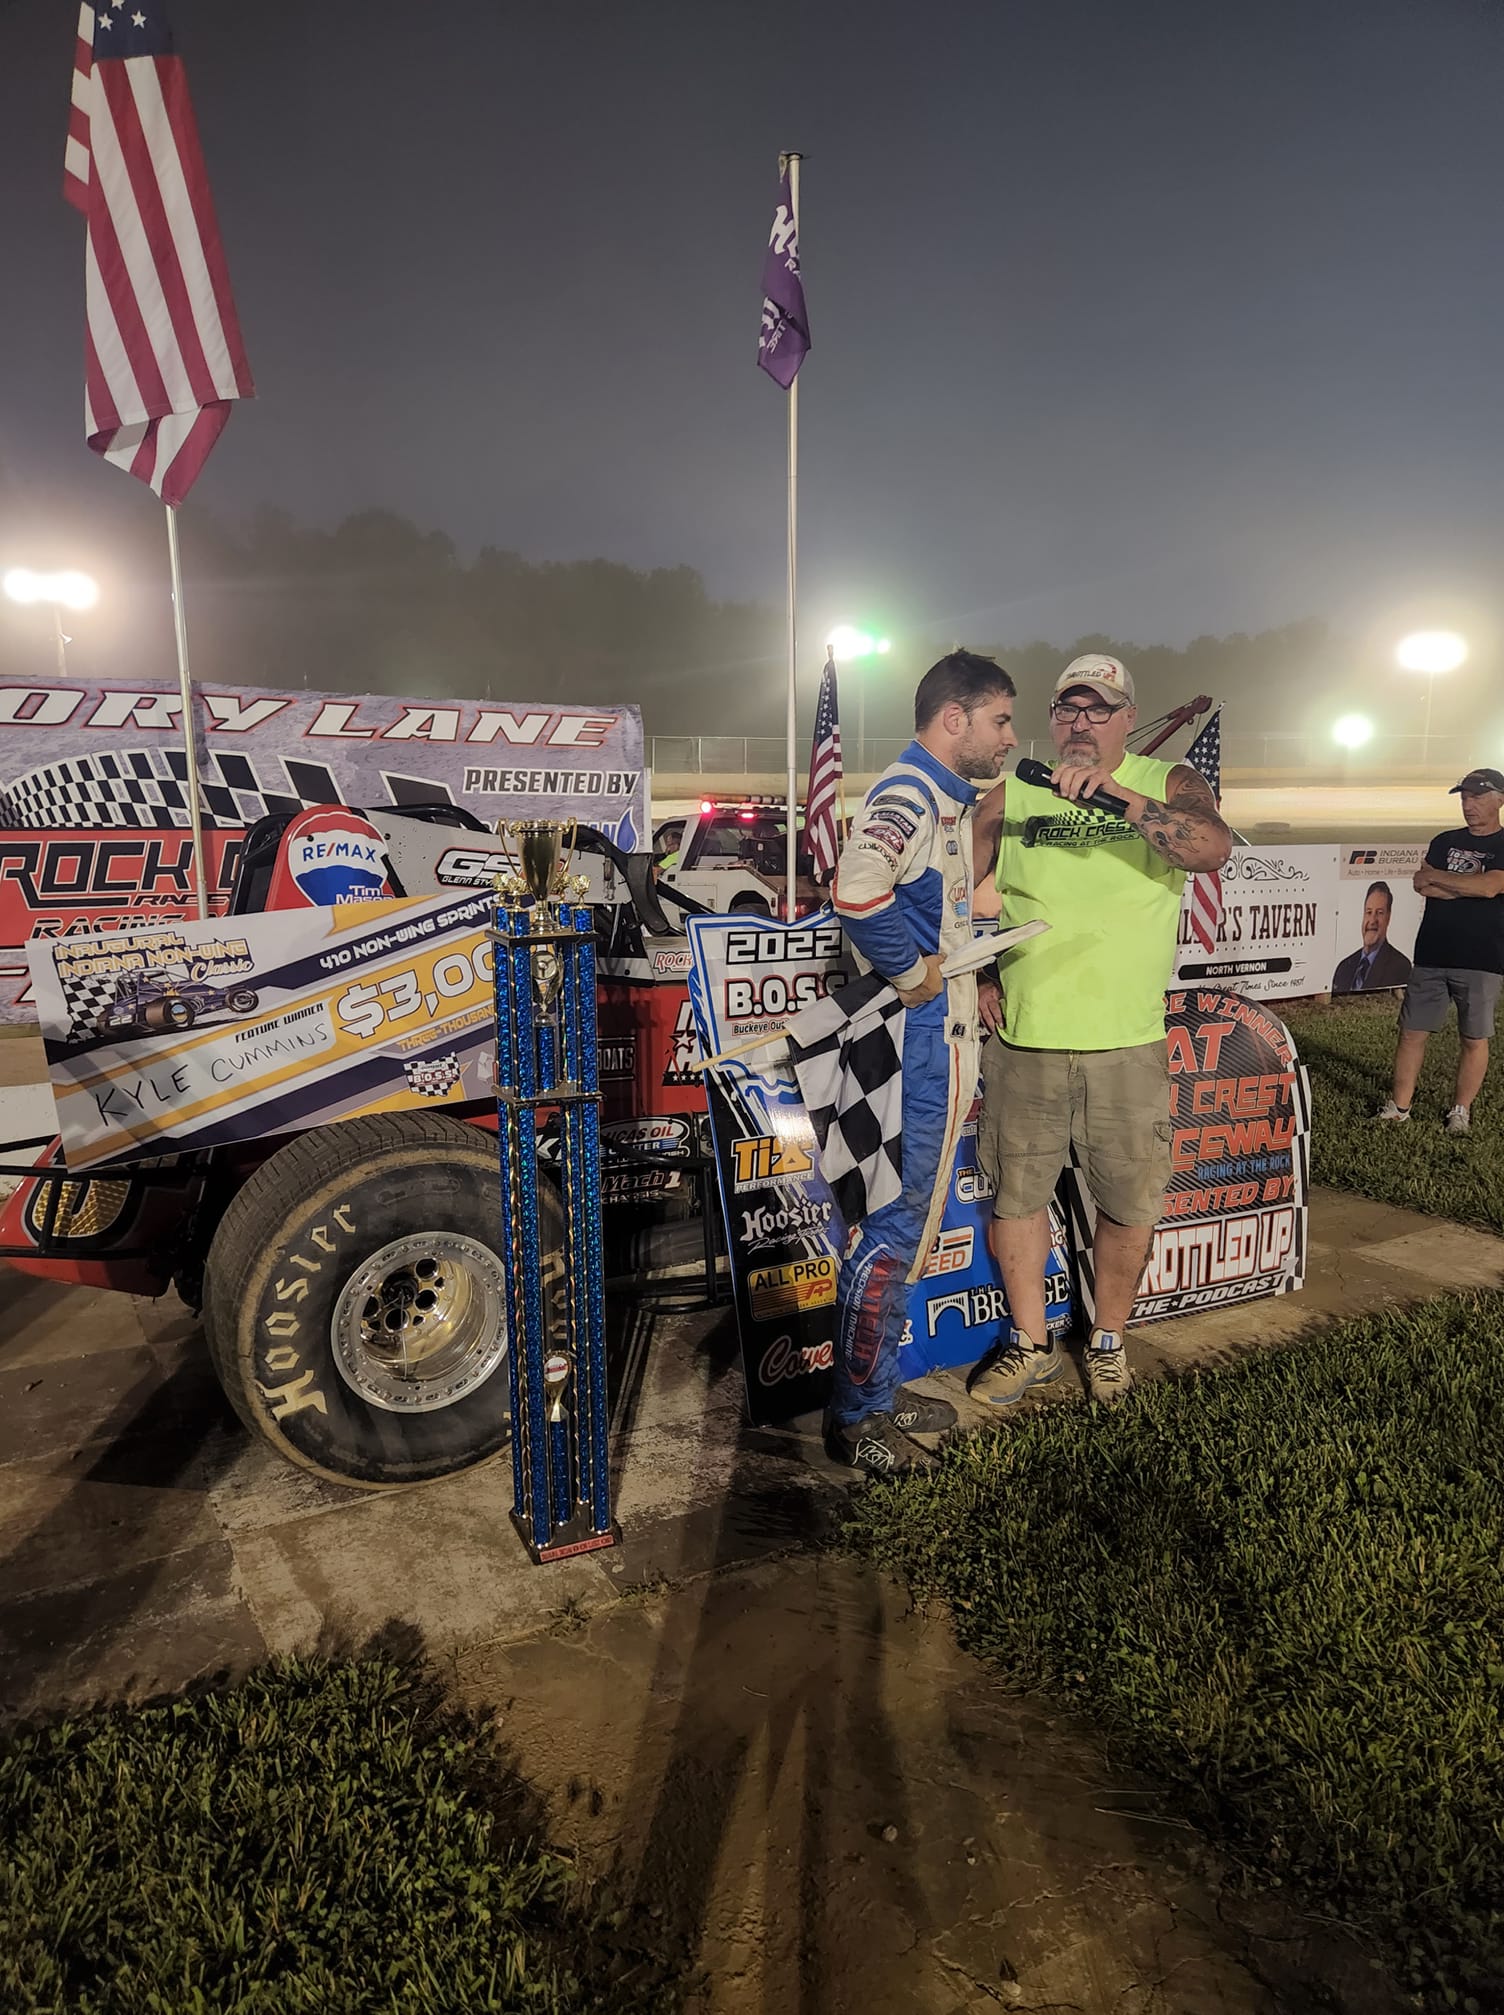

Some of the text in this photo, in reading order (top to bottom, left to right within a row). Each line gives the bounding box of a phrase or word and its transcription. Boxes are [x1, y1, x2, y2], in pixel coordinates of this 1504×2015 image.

[302, 702, 617, 747] LANE
[463, 768, 640, 795] PRESENTED BY
[1039, 826, 1080, 840] ROCK
[302, 842, 376, 862] RE/MAX
[1380, 849, 1419, 857] INDIANA
[0, 840, 194, 909] ROCK
[441, 875, 473, 883] GLENN
[349, 885, 380, 896] Tim
[1249, 903, 1317, 940] TAVERN
[54, 933, 184, 960] INAUGURAL
[58, 940, 248, 978] INDIANA NON-WING
[320, 952, 352, 970] 410
[353, 922, 436, 959] NON-WING
[727, 930, 840, 964] 2022
[190, 960, 253, 982] Classic
[1205, 962, 1267, 976] NORTH VERNON
[1240, 981, 1261, 993] Times
[1263, 979, 1288, 991] Since
[109, 1014, 133, 1026] 22
[235, 1002, 324, 1043] FEATURE WINNER
[733, 1023, 768, 1034] Buckeye
[1197, 993, 1292, 1067] WINNER
[95, 1022, 328, 1127] KYLE CUMMINS
[1193, 1072, 1296, 1119] CREST
[605, 1126, 674, 1141] UCAS OIL
[1198, 1155, 1290, 1180] RACING AT THE ROCK
[736, 1172, 815, 1193] PERFORMANCE
[740, 1195, 832, 1241] Hoosier
[755, 1260, 830, 1291] ALL PRO
[970, 1284, 993, 1296] THE
[971, 1273, 1069, 1327] BRGE
[1178, 1274, 1284, 1308] PODCAST
[256, 1203, 356, 1421] Hoosier
